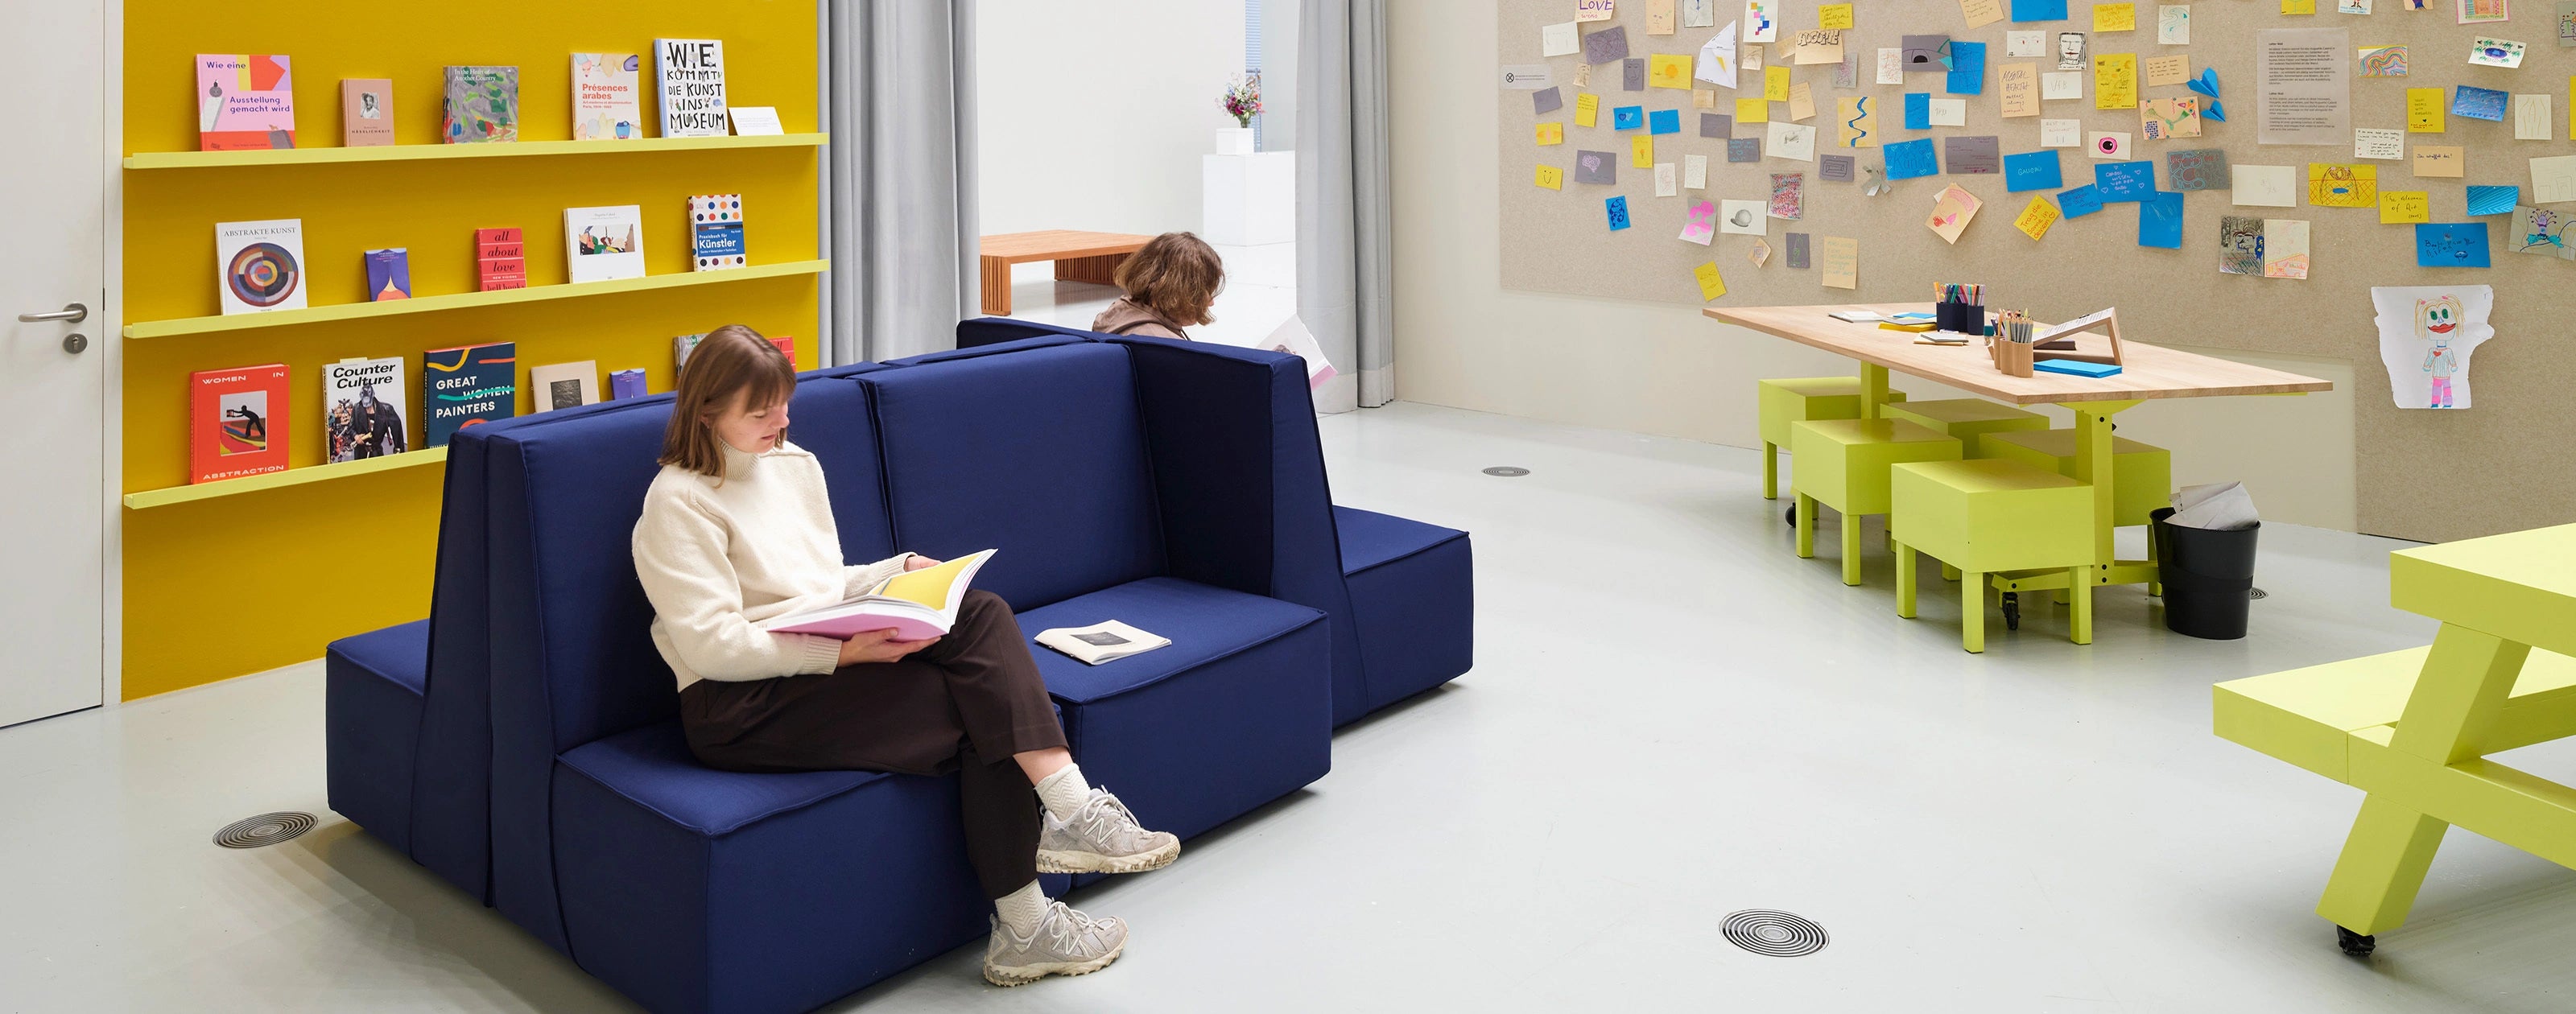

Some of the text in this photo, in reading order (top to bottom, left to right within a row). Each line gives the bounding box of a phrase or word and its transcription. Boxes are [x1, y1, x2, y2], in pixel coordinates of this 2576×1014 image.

[668, 42, 716, 68] WIE
[667, 69, 716, 80] KOMMT
[582, 83, 628, 92] Présences
[668, 83, 721, 97] DIE KUNST
[229, 96, 280, 105] Ausstellung
[582, 92, 612, 100] arabes
[230, 105, 268, 113] gemacht
[682, 98, 703, 111] INS
[670, 113, 725, 130] MUSEUM
[2391, 203, 2400, 212] of
[2021, 204, 2042, 227] Trag die
[2026, 218, 2043, 235] Sonne
[224, 229, 269, 237] ABSTRAKTE
[494, 231, 510, 241] all
[699, 238, 736, 249] Künstler
[488, 245, 518, 257] about
[493, 262, 515, 272] love
[332, 364, 396, 378] Counter
[202, 375, 246, 385] WOMEN
[336, 375, 393, 389] Culture
[436, 376, 477, 390] GREAT
[463, 385, 510, 401] WOMEN
[436, 401, 495, 418] PAINTERS
[203, 464, 284, 480] ABSTRACTION
